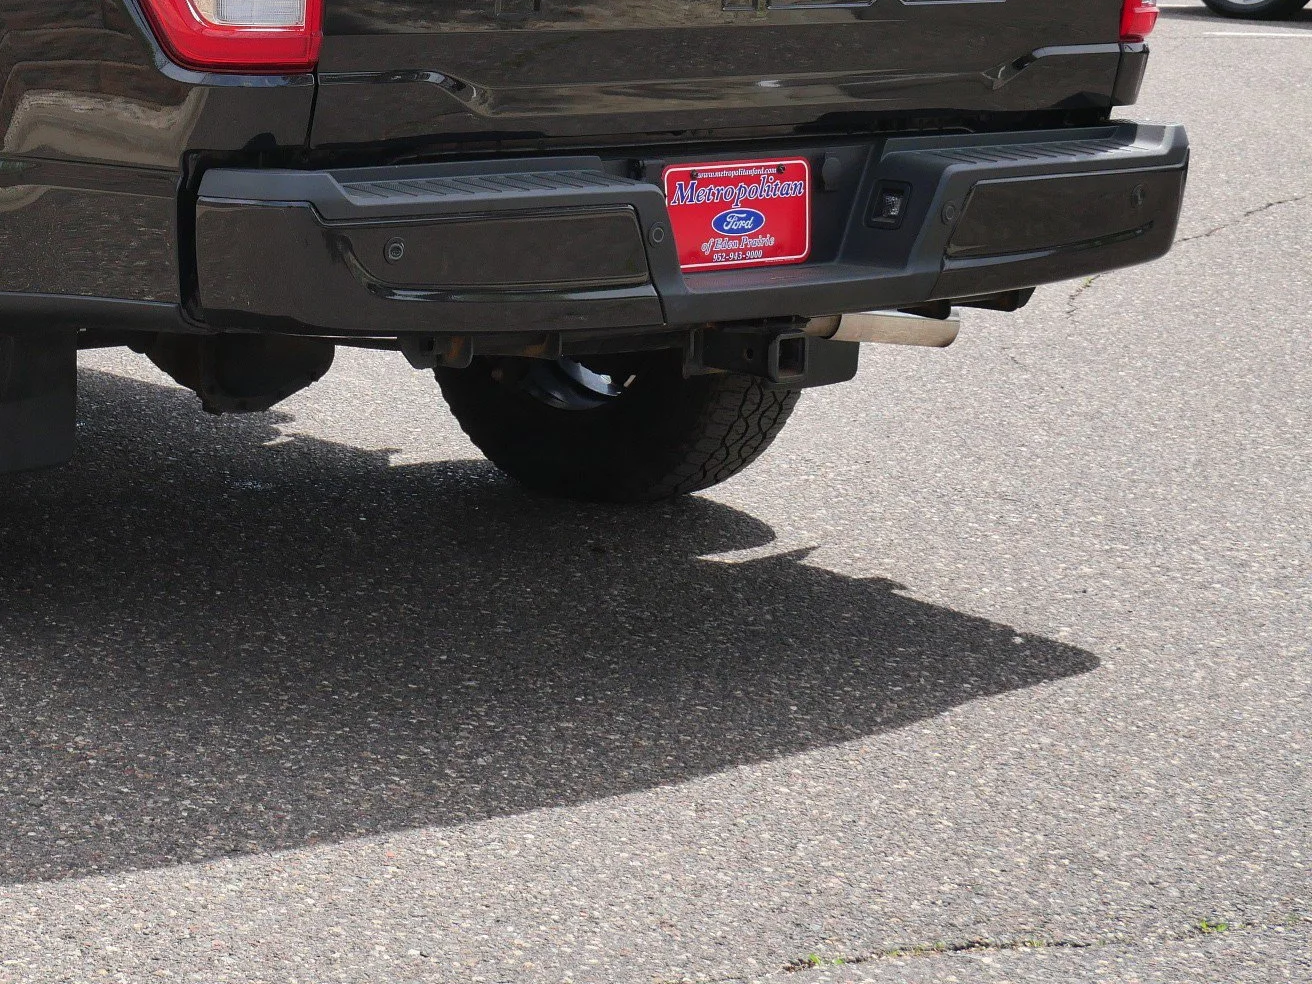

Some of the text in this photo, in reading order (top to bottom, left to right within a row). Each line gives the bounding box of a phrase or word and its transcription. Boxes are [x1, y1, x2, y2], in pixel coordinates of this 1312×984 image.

[671, 175, 804, 208] Metropolitan
[723, 213, 754, 230] Ford
[701, 238, 714, 256] of
[713, 237, 738, 251] Eden
[713, 249, 763, 263] 952-943-9000
